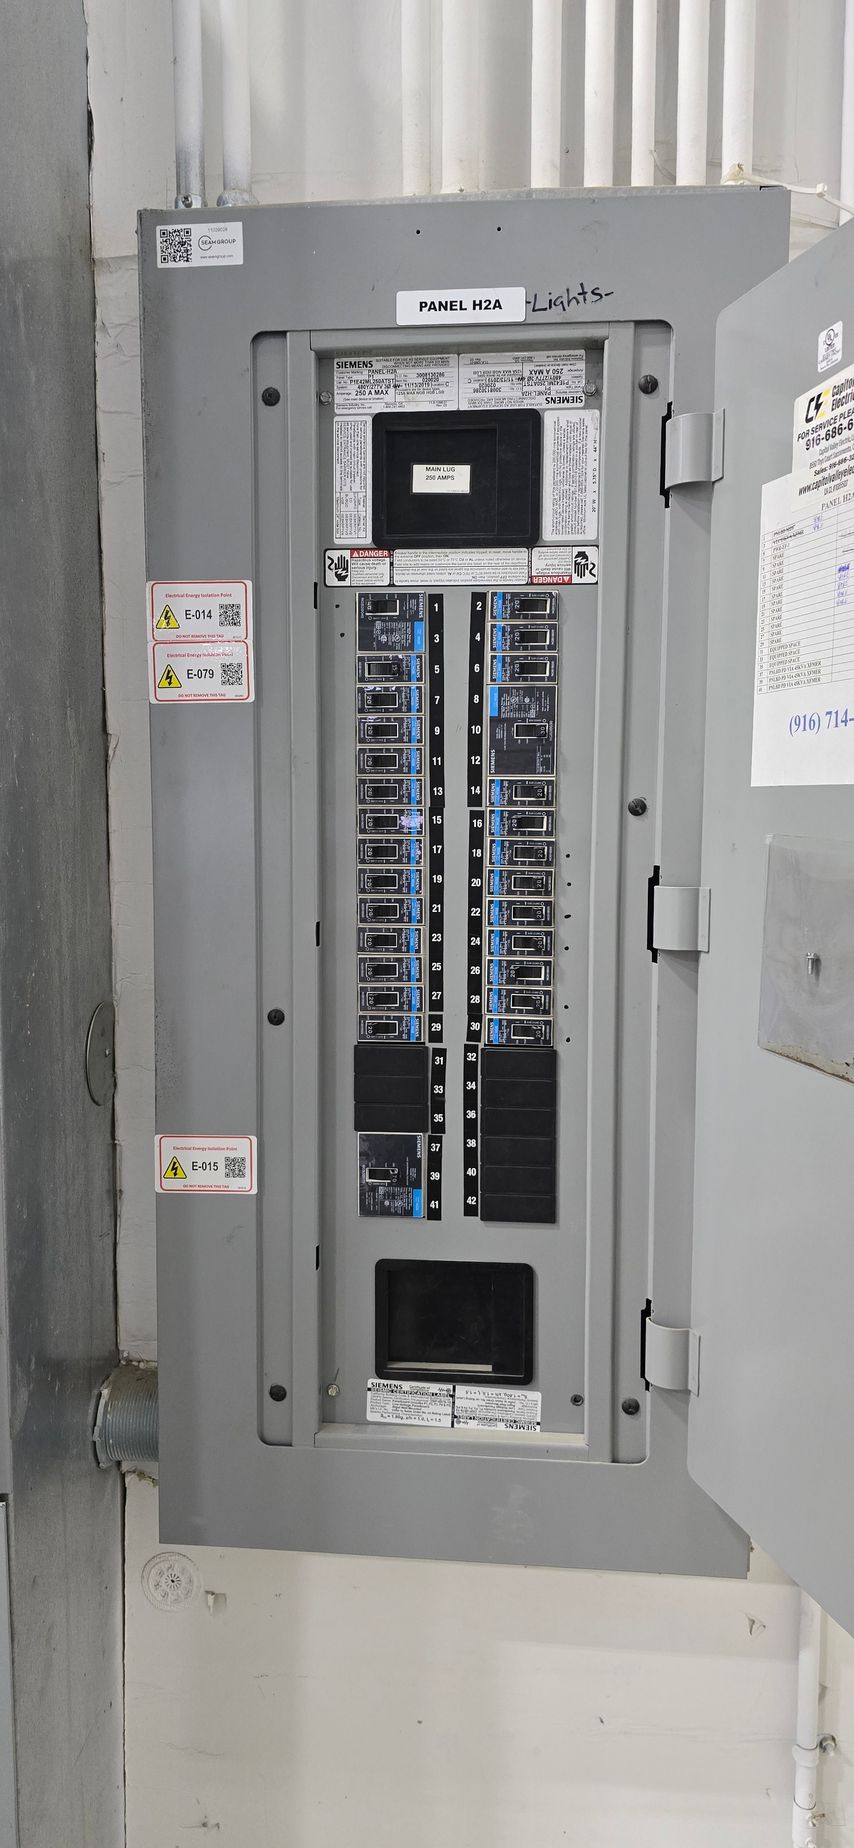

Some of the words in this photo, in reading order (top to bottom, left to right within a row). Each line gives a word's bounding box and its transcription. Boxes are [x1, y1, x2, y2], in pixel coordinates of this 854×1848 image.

[419, 300, 467, 312] PANEL
[472, 299, 502, 311] H2A
[336, 360, 373, 369] SIEMENS
[545, 396, 583, 404] SIEMENS
[797, 429, 810, 442] FOR
[811, 415, 838, 435] SERVICE
[821, 496, 840, 511] PANEL
[433, 603, 439, 611] 1
[476, 602, 482, 610] 2
[515, 600, 520, 609] 20
[185, 609, 212, 620] E-014
[433, 634, 440, 642] 3
[475, 633, 481, 641] 4
[515, 631, 520, 641] 20
[434, 665, 440, 673] 5
[474, 664, 480, 672] 6
[515, 663, 520, 672] 20
[187, 669, 214, 679] E-079
[434, 696, 440, 704] 7
[473, 695, 480, 703] 8
[790, 712, 821, 737] (916)
[825, 708, 854, 729] 714-
[434, 727, 440, 735] 9
[470, 725, 482, 734] 10
[541, 726, 546, 734] 30
[432, 757, 441, 765] 11
[470, 756, 481, 764] 12
[432, 787, 443, 795] 13
[470, 786, 481, 794] 14
[537, 788, 542, 796] 20
[431, 816, 442, 824] 15
[472, 819, 483, 827] 16
[432, 845, 443, 853] 17
[471, 849, 482, 857] 18
[432, 875, 443, 883] 19
[537, 880, 541, 888] 20
[432, 904, 441, 912] 21
[470, 908, 481, 916] 22
[470, 937, 481, 945] 24
[470, 966, 481, 974] 26
[470, 995, 481, 1003] 28
[431, 1023, 442, 1031] 29
[470, 1022, 481, 1030] 30
[466, 1053, 477, 1061] 32
[433, 1085, 444, 1093] 33
[433, 1114, 444, 1122] 35
[466, 1110, 477, 1118] 36
[466, 1139, 477, 1147] 38
[192, 1162, 219, 1171] E-015
[430, 1172, 440, 1180] 39
[466, 1168, 477, 1176] 40
[371, 1382, 403, 1390] SIEMENS
[504, 1423, 537, 1432] SIEMENS
